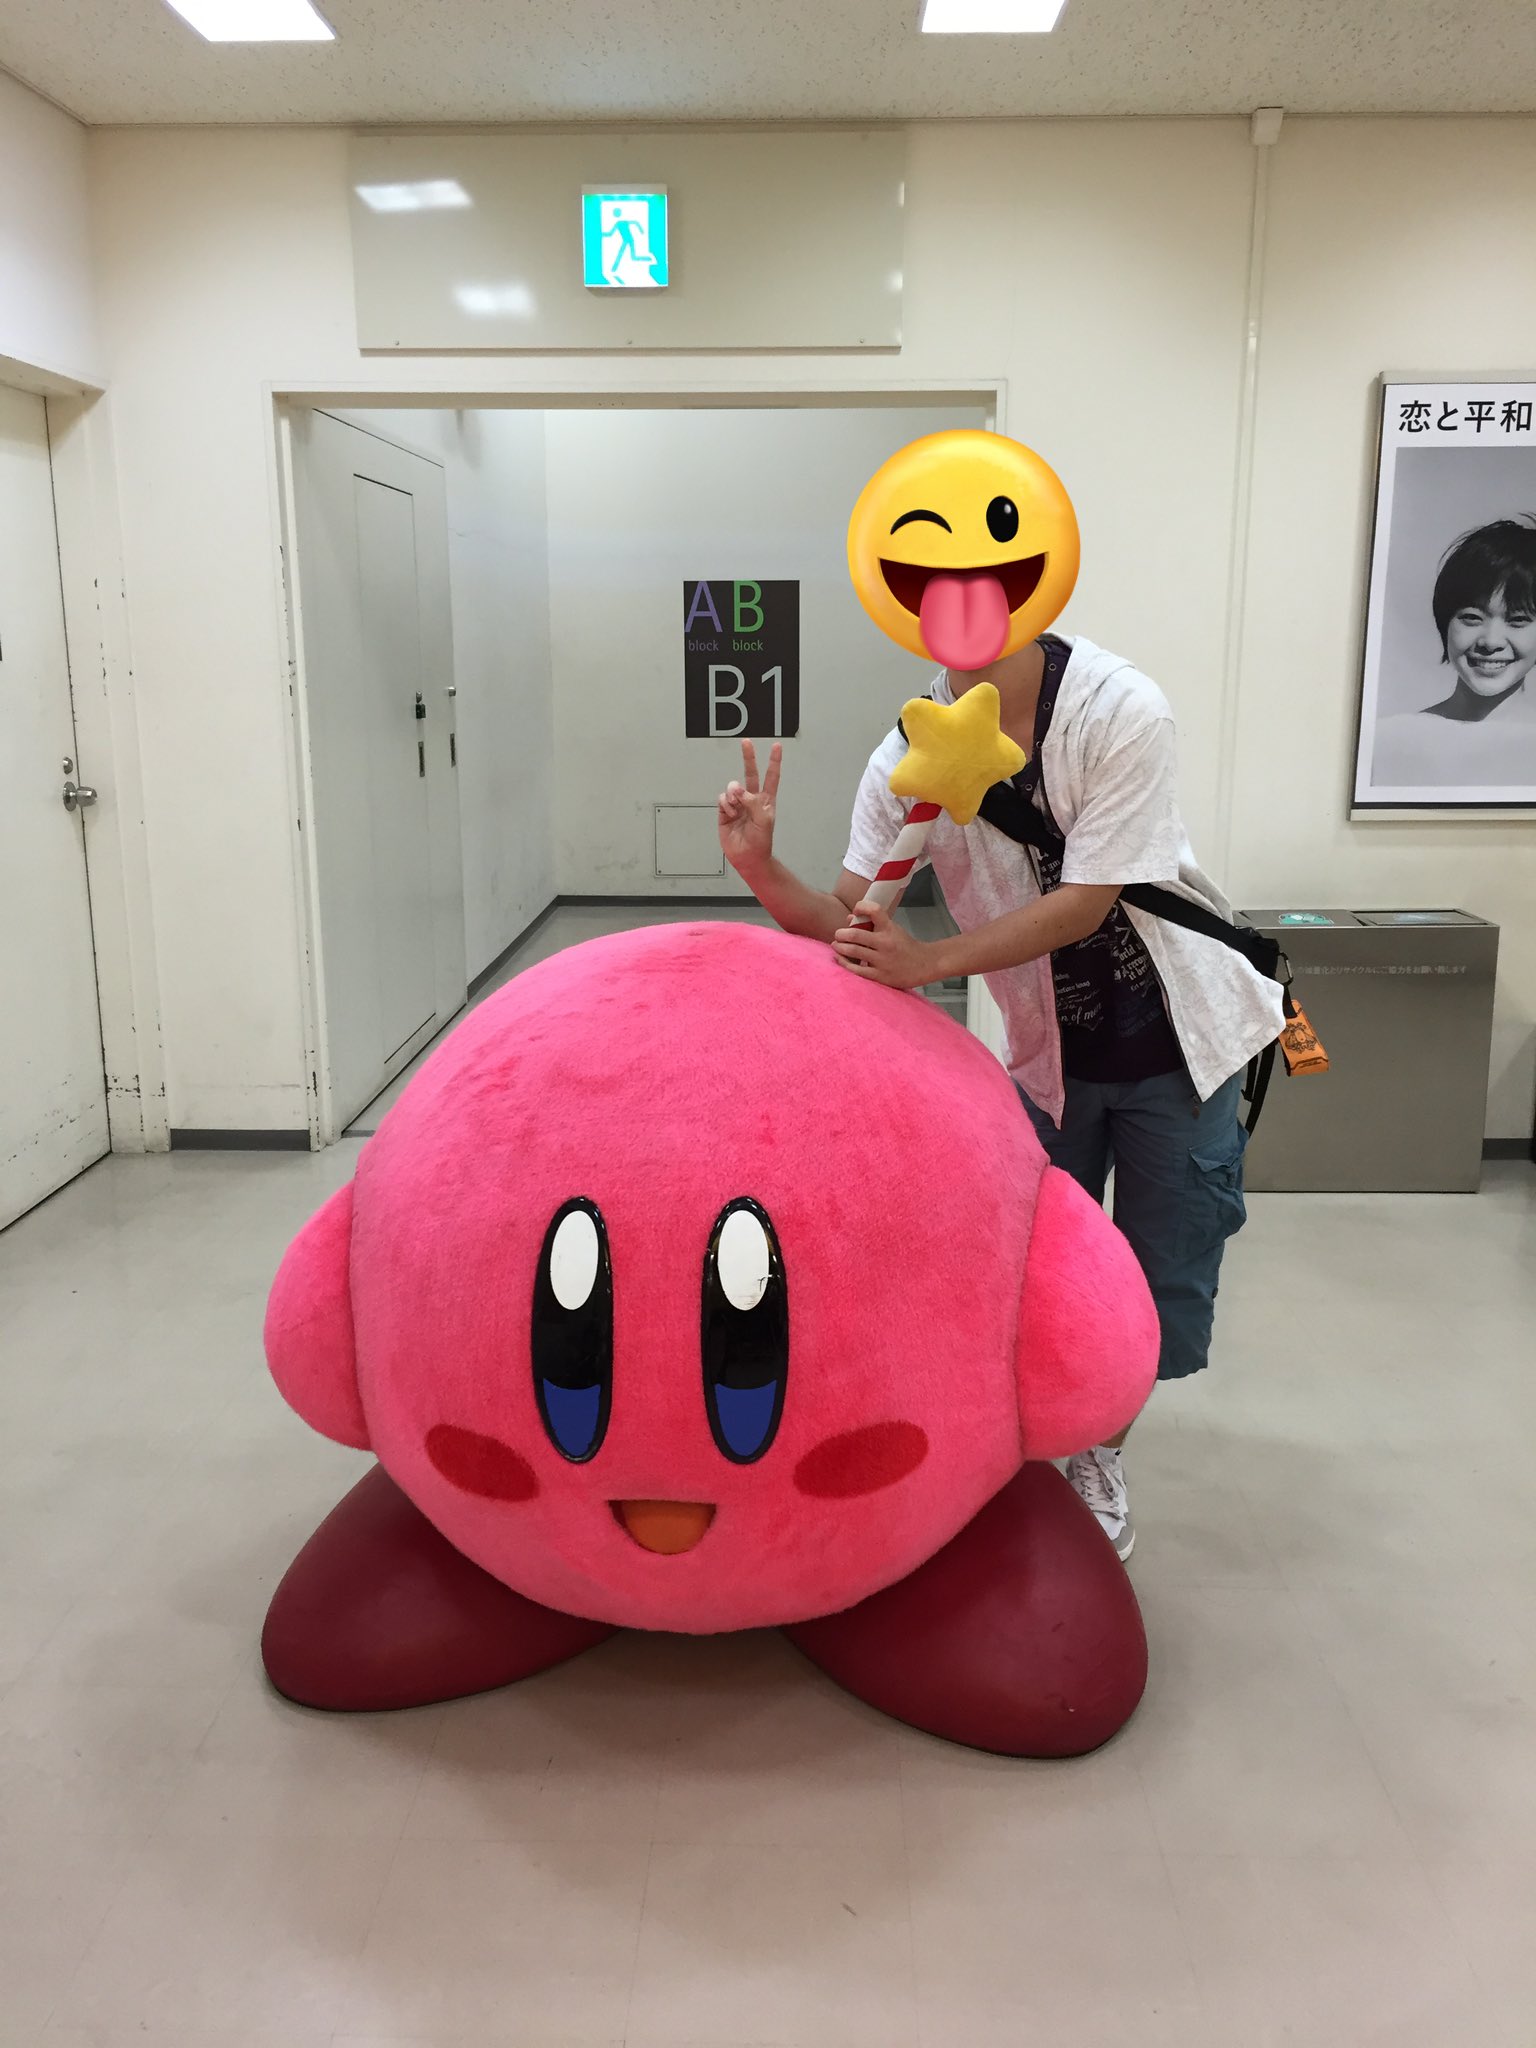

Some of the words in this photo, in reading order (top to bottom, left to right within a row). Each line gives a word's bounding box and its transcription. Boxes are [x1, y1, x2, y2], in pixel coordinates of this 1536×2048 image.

[1398, 400, 1533, 433] 恋と平和
[684, 580, 723, 632] A
[733, 579, 764, 633] B
[688, 639, 720, 651] block
[732, 639, 764, 651] block
[708, 664, 782, 737] B1
